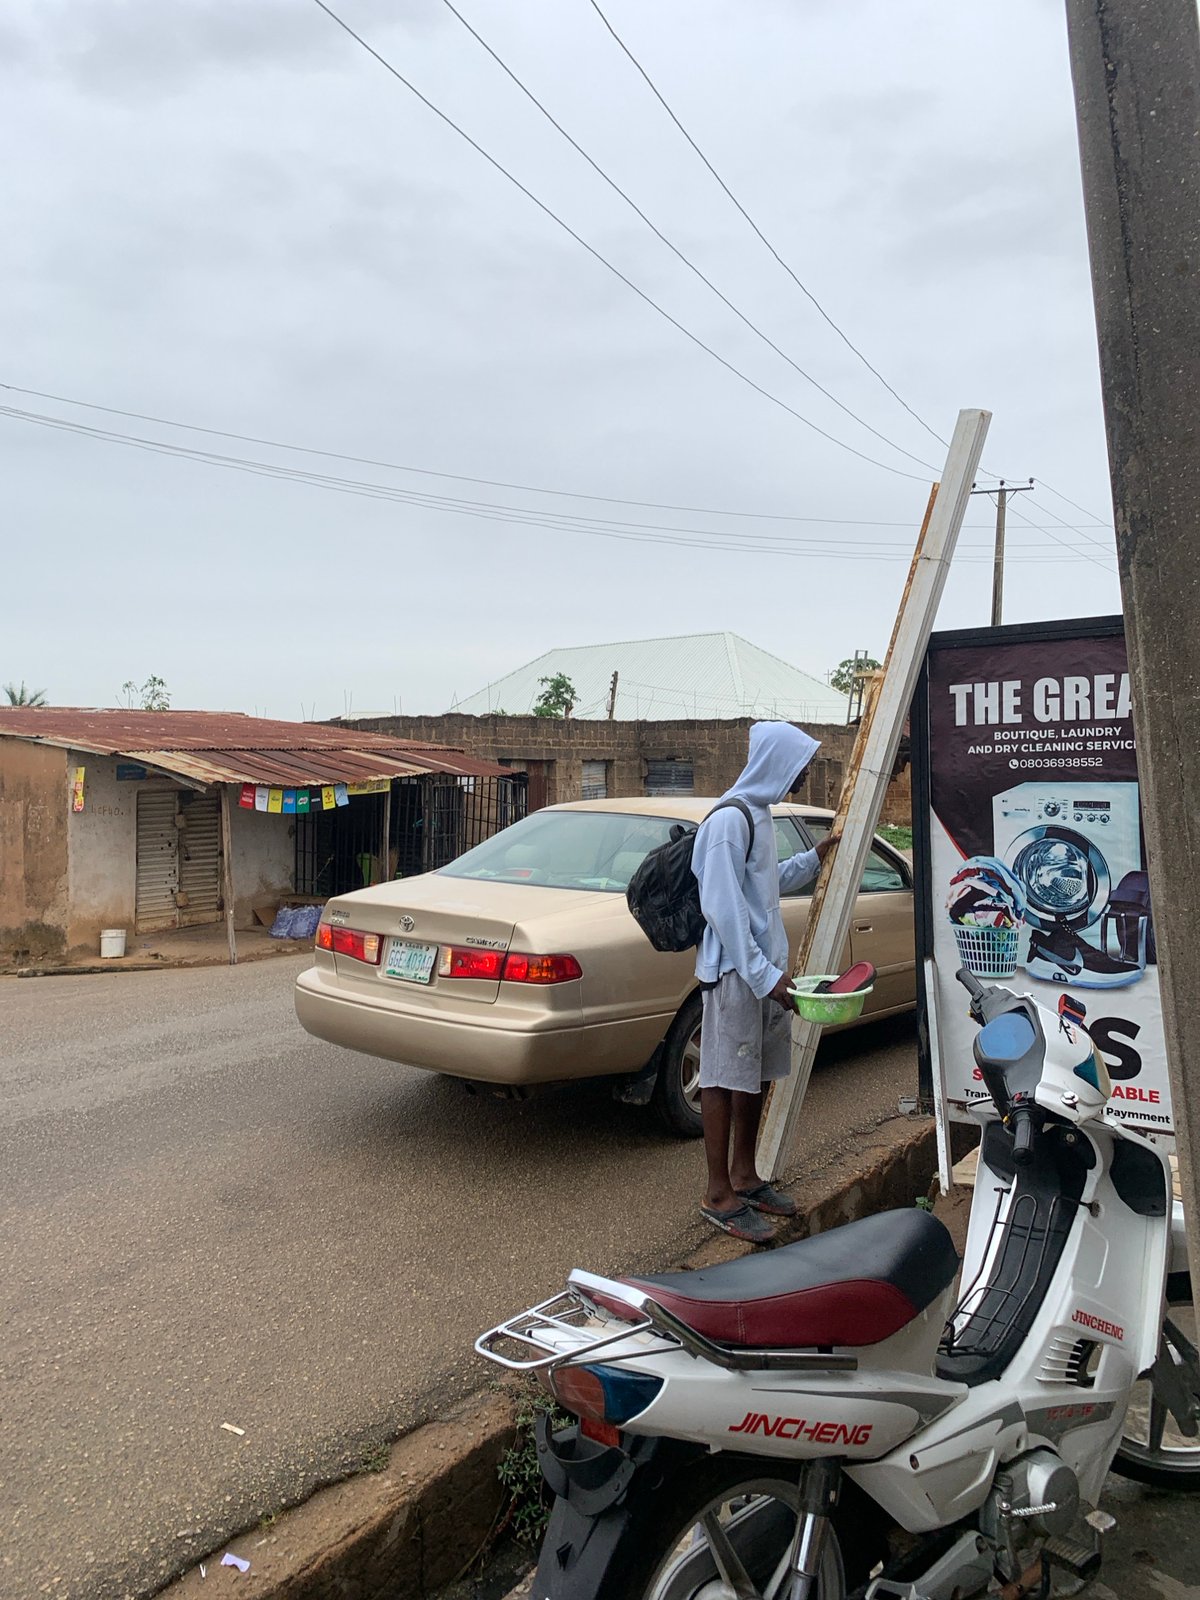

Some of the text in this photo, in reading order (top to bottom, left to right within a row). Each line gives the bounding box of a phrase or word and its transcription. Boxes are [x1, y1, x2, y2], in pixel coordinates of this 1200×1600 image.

[949, 680, 1022, 727] THE
[994, 726, 1122, 741] BOUTIQUE, LAUNDRY
[967, 744, 993, 754] AND
[994, 743, 1018, 753] DRY
[1021, 741, 1083, 752] CLEANING
[1020, 757, 1103, 769] 08036938552
[1106, 1107, 1171, 1124] Paymment
[1072, 1309, 1123, 1341] JINCHENG
[728, 1411, 873, 1446] JINCHENG
